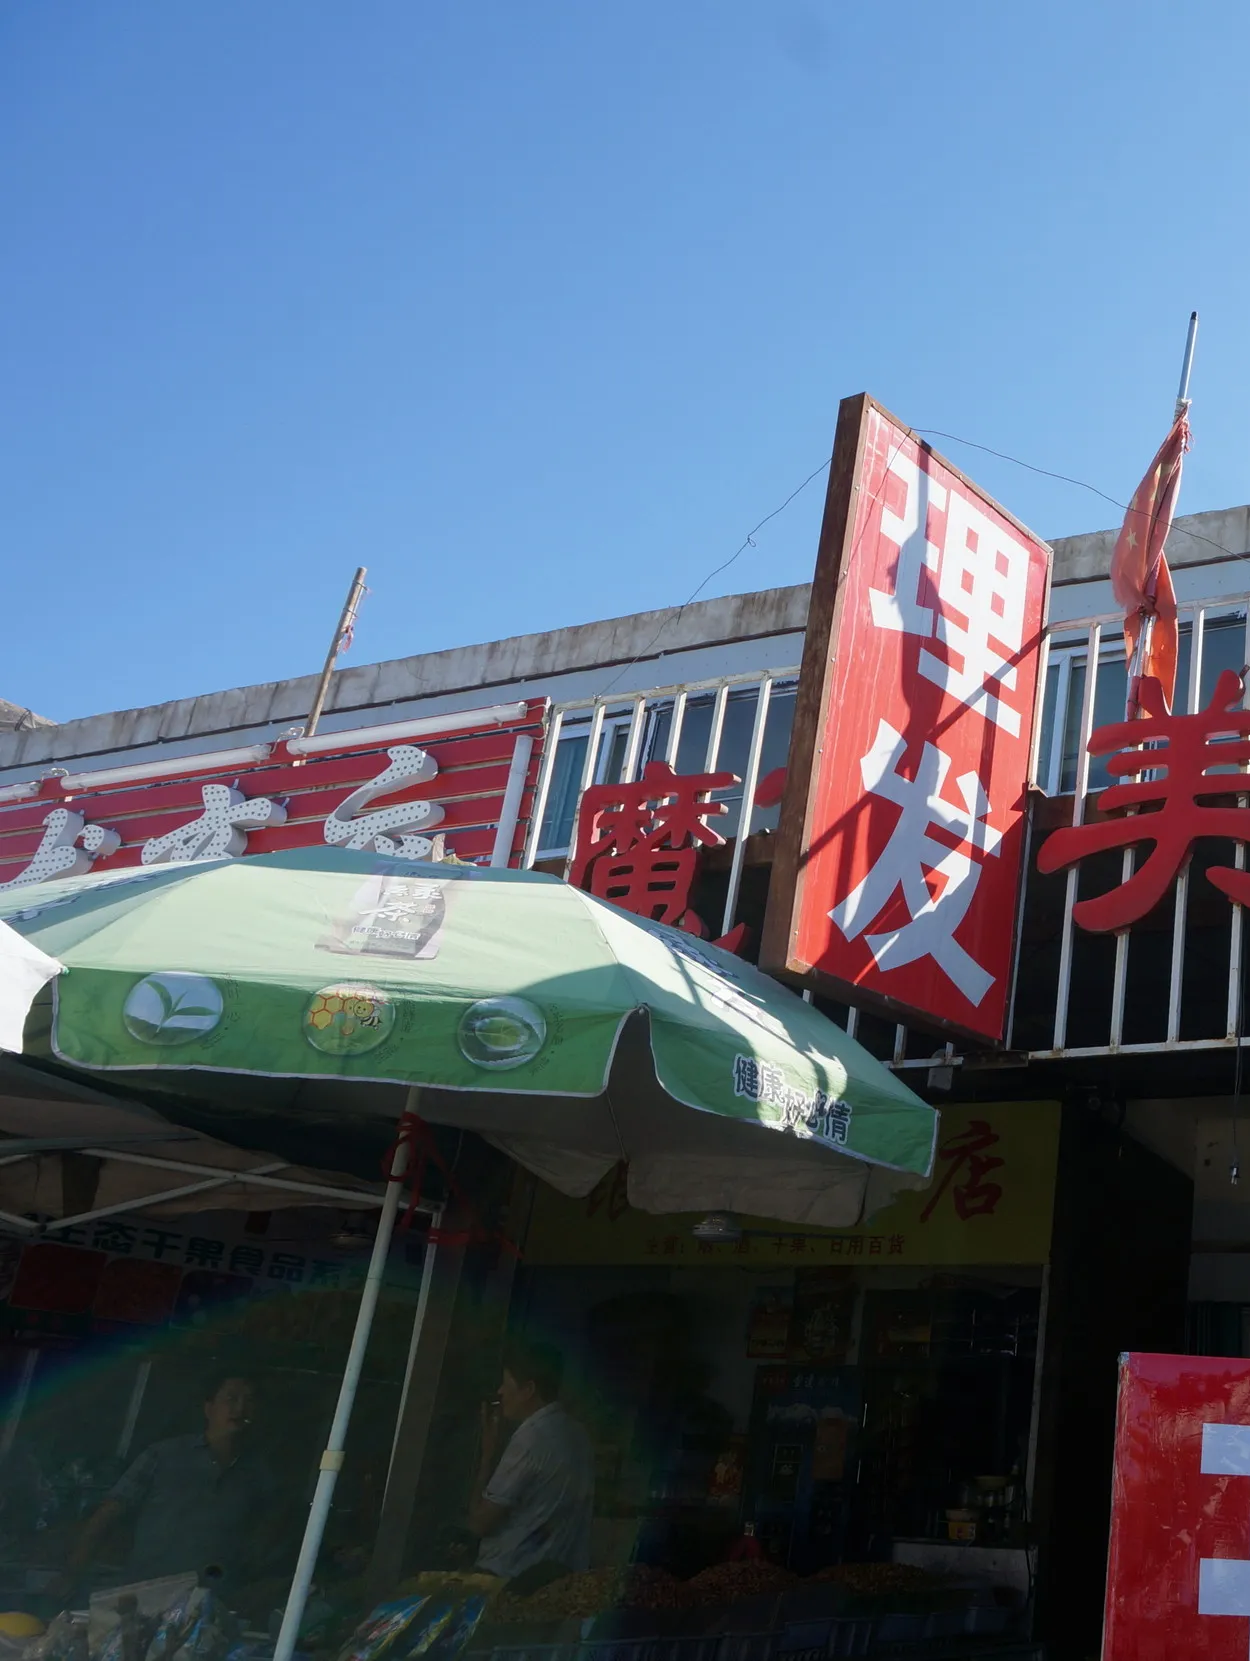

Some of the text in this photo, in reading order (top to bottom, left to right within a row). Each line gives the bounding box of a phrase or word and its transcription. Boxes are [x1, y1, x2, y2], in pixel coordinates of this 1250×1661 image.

[826, 443, 1031, 1009] 理发
[733, 1053, 853, 1145] 健康好心情
